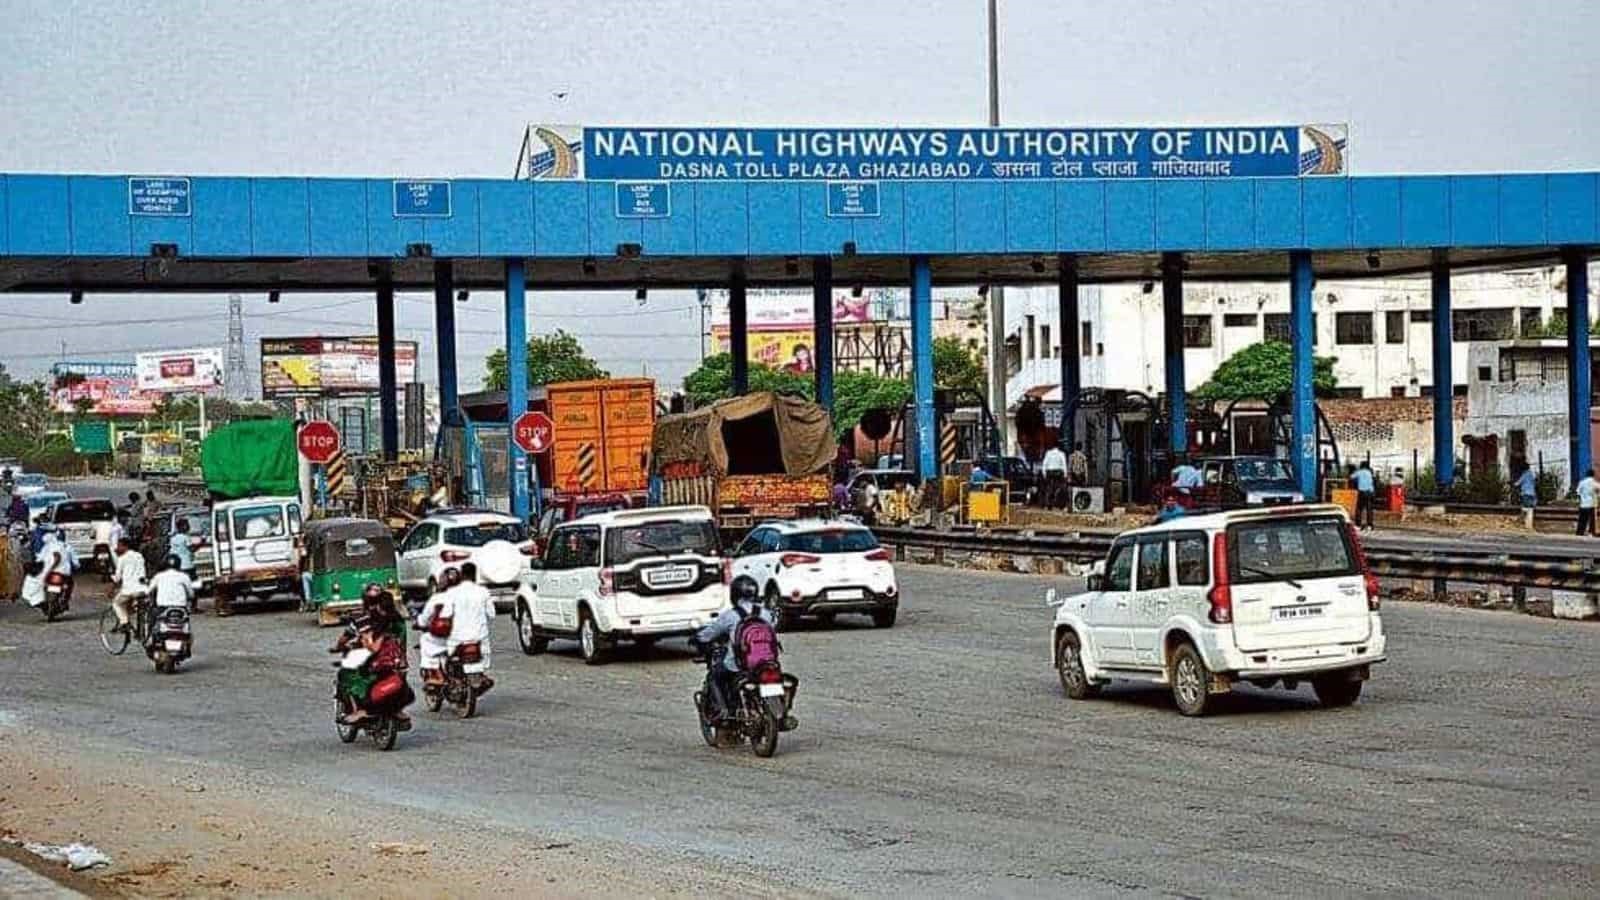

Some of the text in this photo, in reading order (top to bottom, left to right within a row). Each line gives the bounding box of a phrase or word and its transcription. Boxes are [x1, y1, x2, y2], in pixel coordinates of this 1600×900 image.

[594, 130, 1290, 157] NATIONAL HIGHWAYS AUTHORITY OF INDIA
[660, 156, 1232, 177] DASNA TOLL PLAZA GHAZIABAD / डासना टोल प्लाजा गाजियाबाद
[519, 427, 548, 438] STOP
[303, 435, 334, 447] STOP
